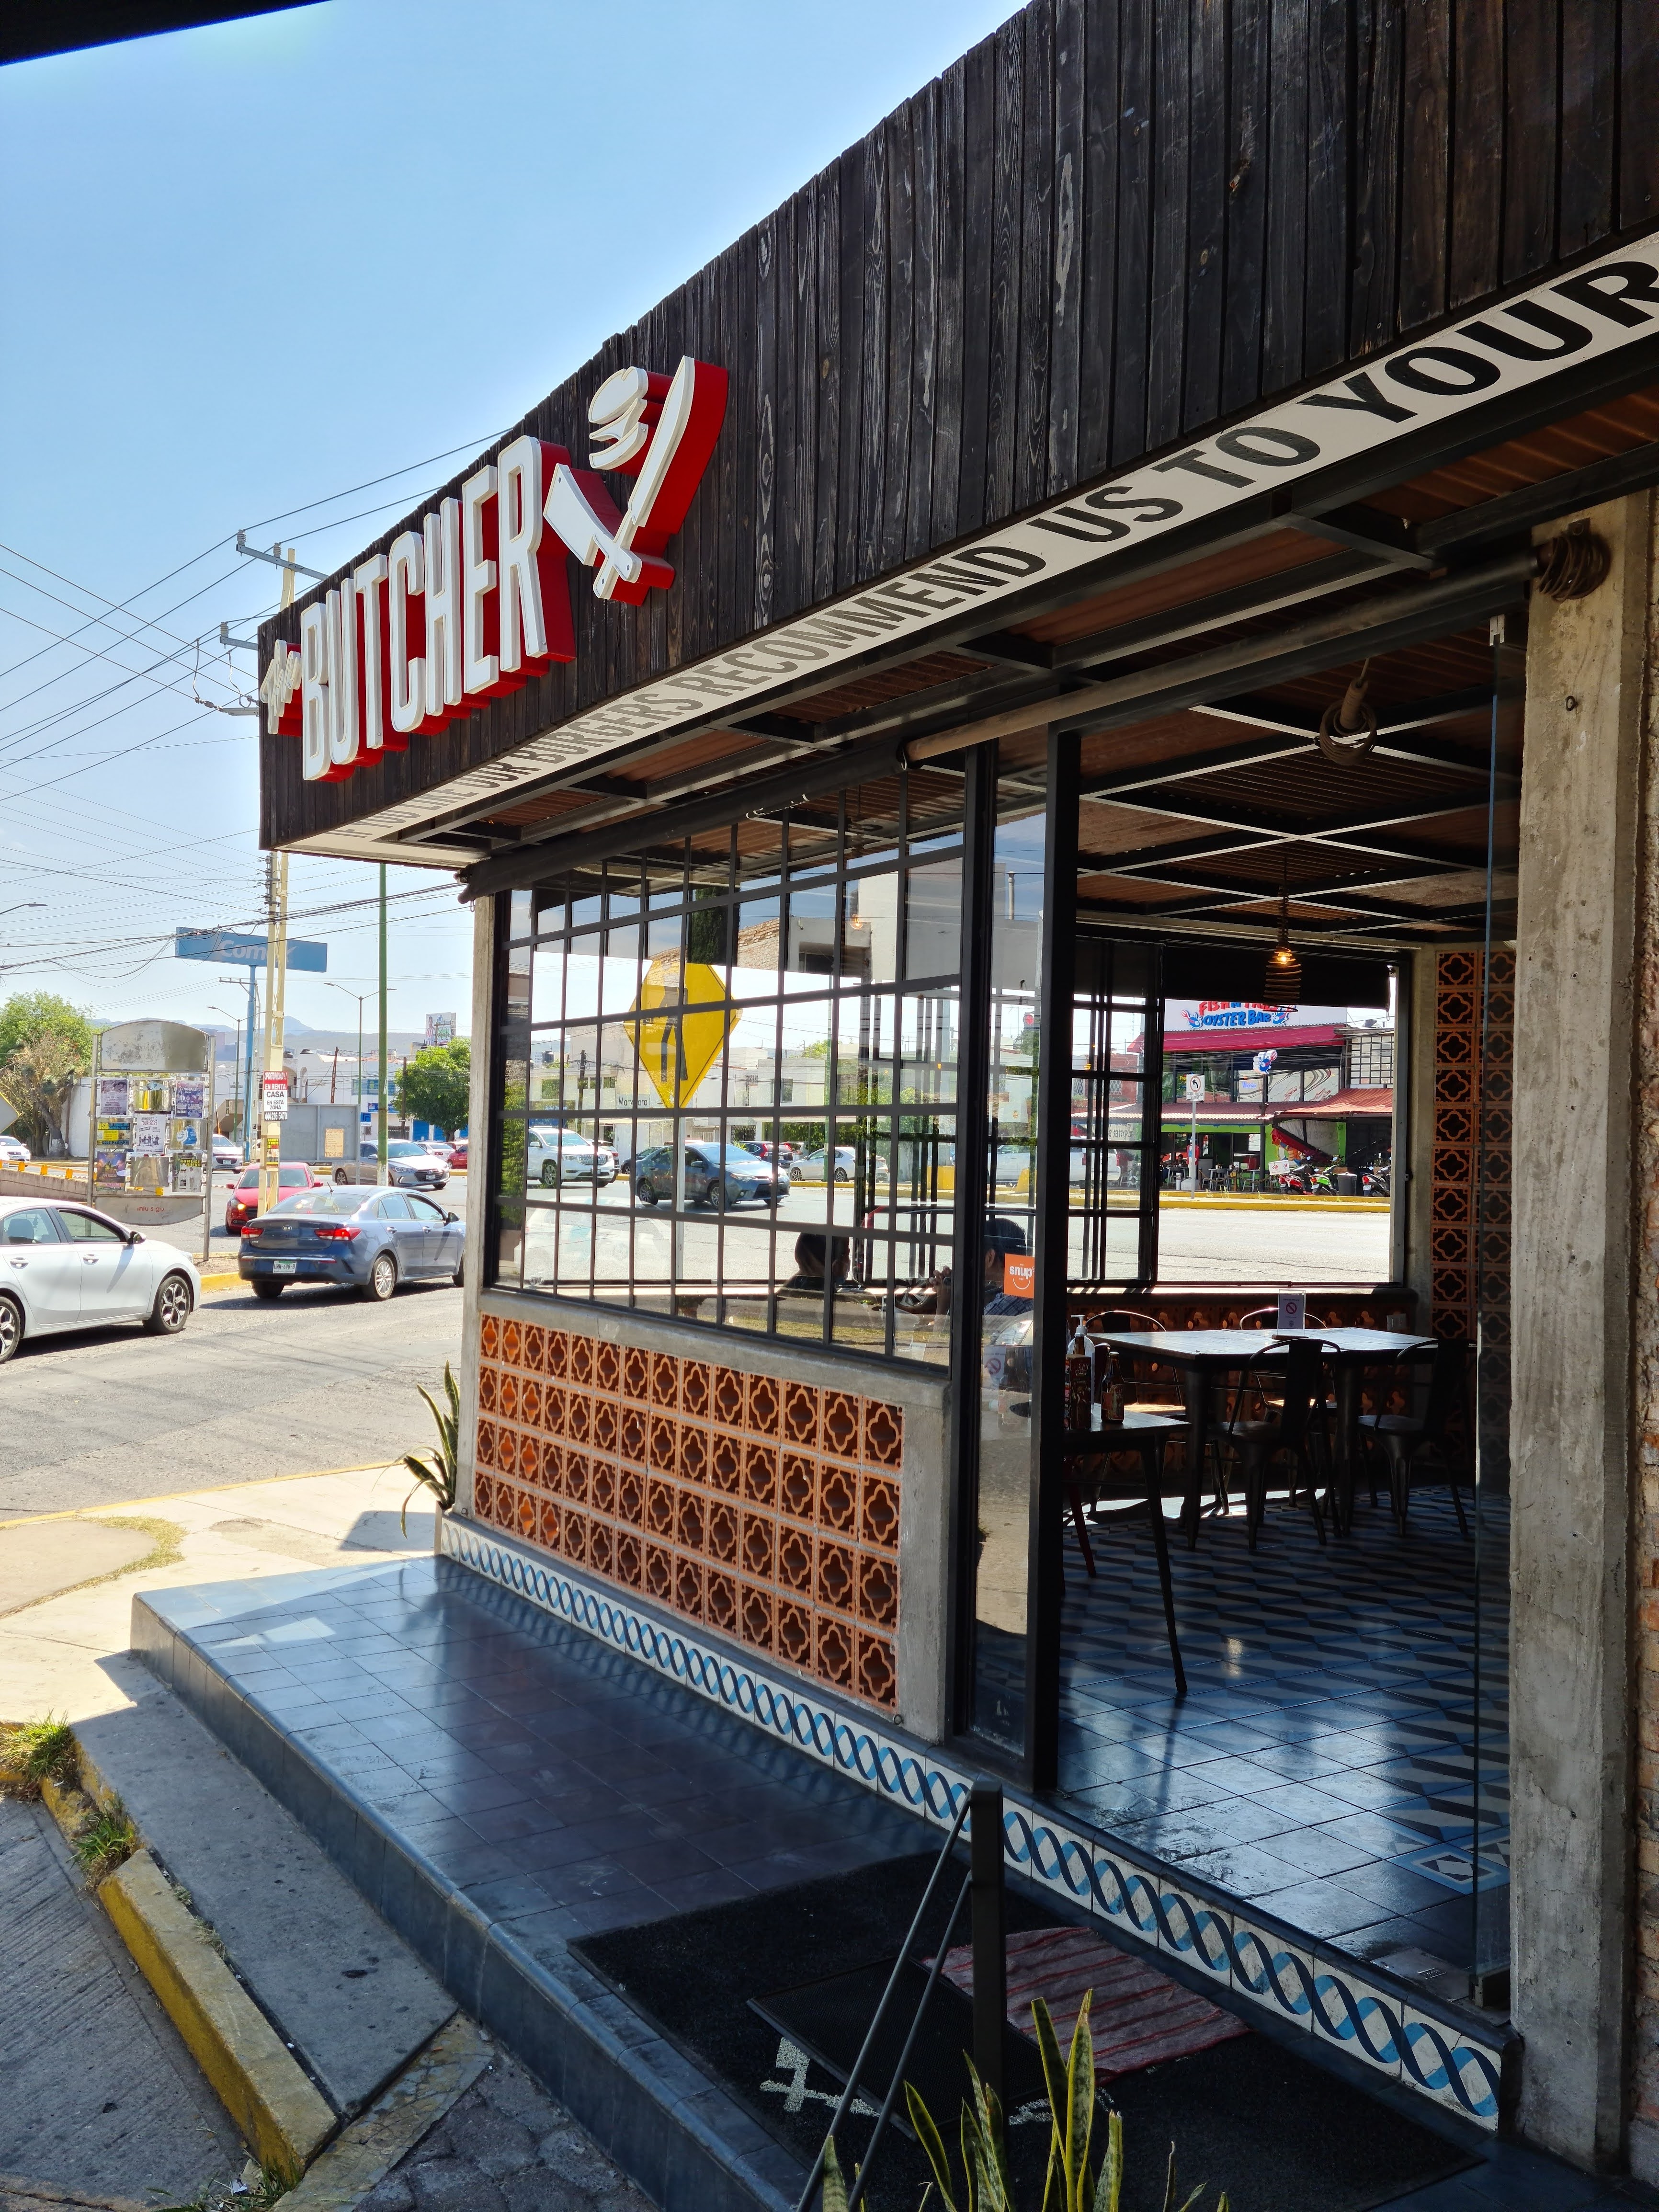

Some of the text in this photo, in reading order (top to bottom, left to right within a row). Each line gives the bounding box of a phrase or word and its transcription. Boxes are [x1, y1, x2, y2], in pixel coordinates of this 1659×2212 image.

[328, 261, 1659, 838] IF YOU LIKE OUR BURGERS RECOMMEND US TO YOUR
[300, 435, 548, 781] BUTCHER
[260, 639, 302, 735] The
[220, 940, 298, 963] Comx
[1203, 1010, 1272, 1026] OYSTER BAR
[278, 1112, 287, 1120] 5470
[1009, 1266, 1033, 1279] snup
